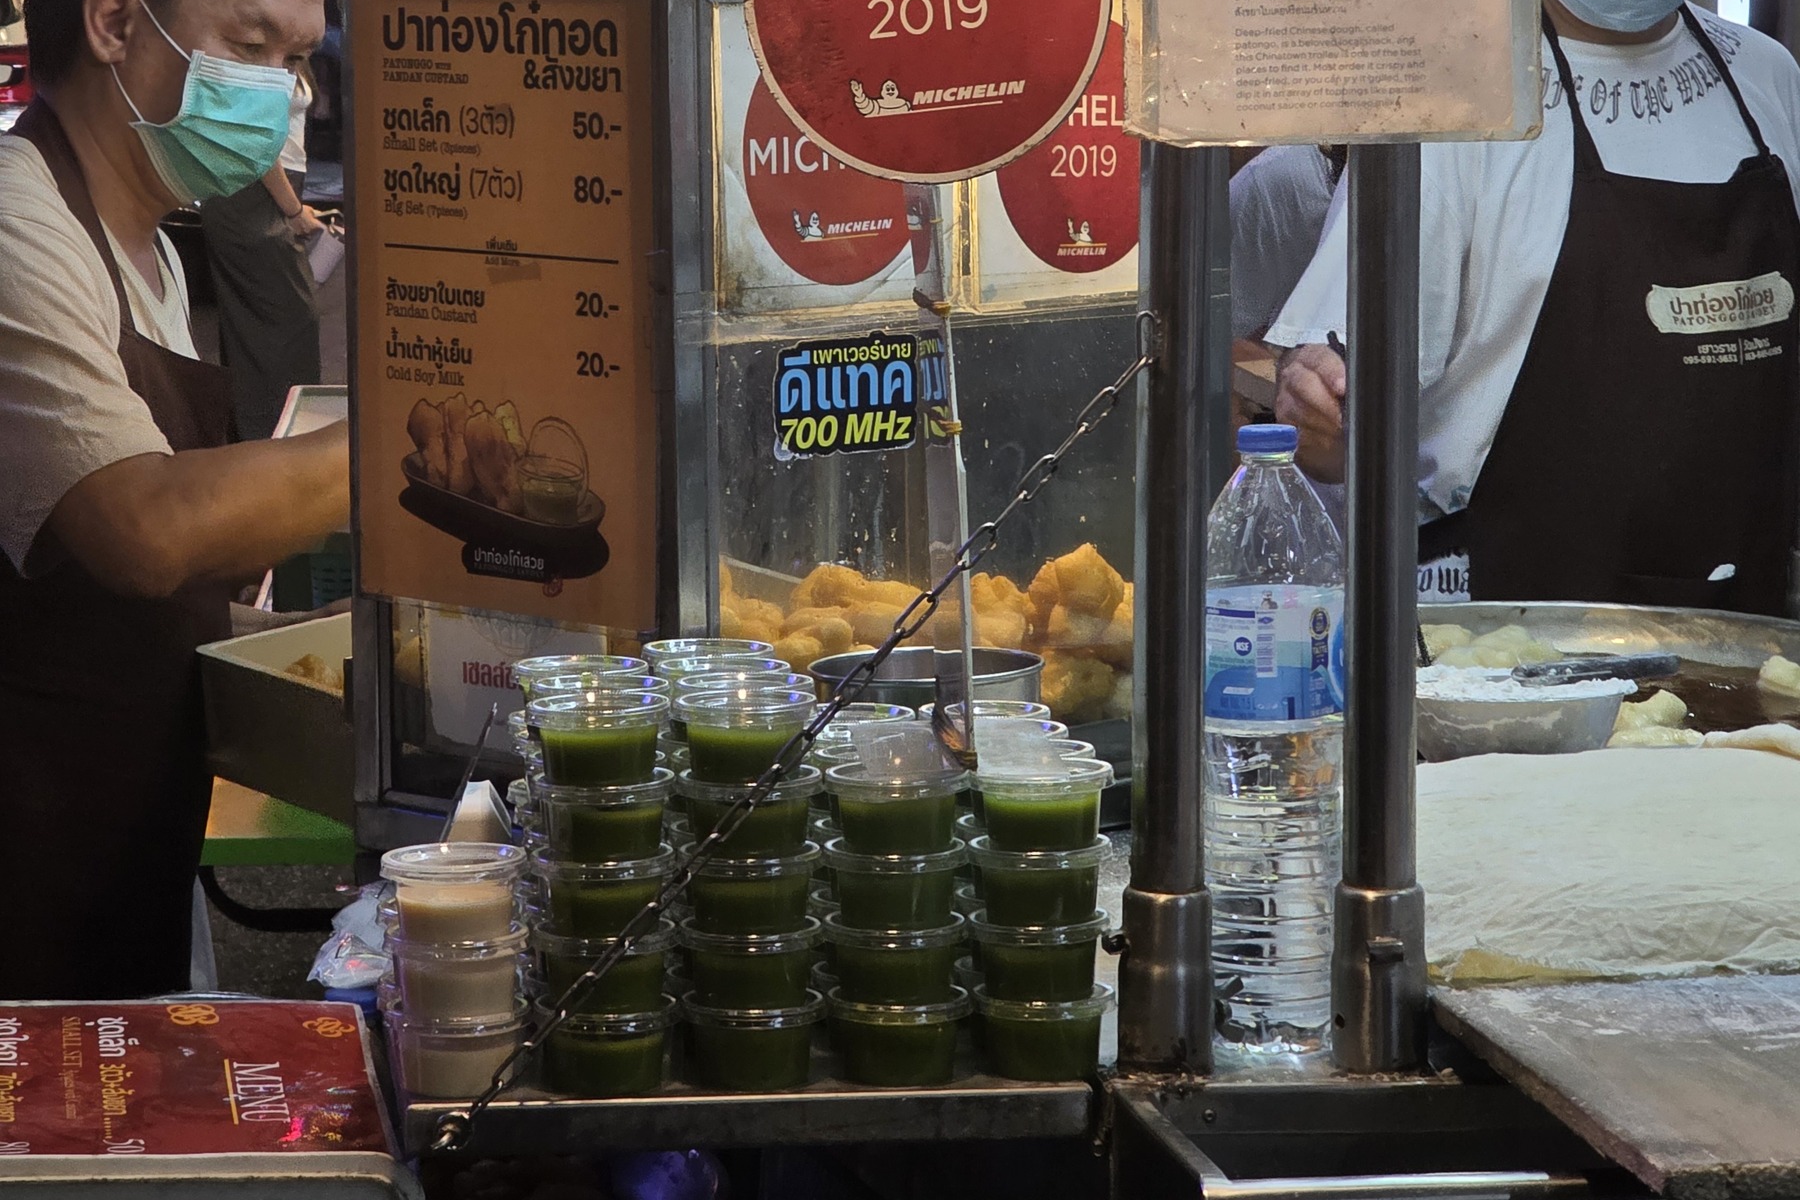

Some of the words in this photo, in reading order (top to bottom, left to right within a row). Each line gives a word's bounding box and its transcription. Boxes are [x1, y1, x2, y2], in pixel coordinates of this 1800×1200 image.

[382, 0, 618, 57] ปาท่องโก๋ทอด
[1235, 27, 1288, 38] Deep-fried
[1289, 26, 1330, 36] Chinese
[1365, 23, 1395, 33] called
[1255, 51, 1307, 61] Chinatown
[383, 71, 423, 83] PANDAN
[523, 56, 623, 92] &สังขยา
[912, 79, 1026, 107] MICHELIN
[383, 97, 450, 136] ชุดเล็ก
[459, 104, 516, 139] (3ตัว)
[572, 111, 622, 140] 50.-
[383, 137, 416, 152] Small
[418, 139, 438, 152] Set
[1050, 144, 1118, 178] 2019
[384, 162, 461, 204] ชุดใหญ่
[469, 167, 523, 203] (7ตัว)
[574, 175, 623, 205] 80.-
[384, 199, 404, 216] Big
[405, 201, 425, 215] Set
[827, 218, 893, 235] MICHELIN
[1056, 246, 1107, 257] MICHELIN
[386, 277, 485, 308] สังขยาใบเตย
[575, 291, 620, 319] 20.-
[386, 303, 429, 319] Pandan
[431, 306, 477, 325] Custard
[386, 327, 472, 370] น้ำเต้าหู้เย็น
[576, 351, 621, 380] 20.-
[813, 339, 911, 364] เพาเวอร์บาย
[386, 365, 412, 382] Cold
[414, 367, 436, 387] Soy
[438, 370, 465, 387] Milk
[780, 350, 912, 413] ดีแทค
[780, 415, 838, 450] 700
[844, 410, 912, 445] MHz
[474, 547, 545, 571] ปาท่องโก๋เสวย
[1235, 641, 1250, 652] NSF
[62, 1016, 82, 1049] SMALL
[85, 1017, 140, 1057] ชุดเล็ก
[63, 1050, 83, 1067] SET
[233, 1061, 291, 1123] MENU
